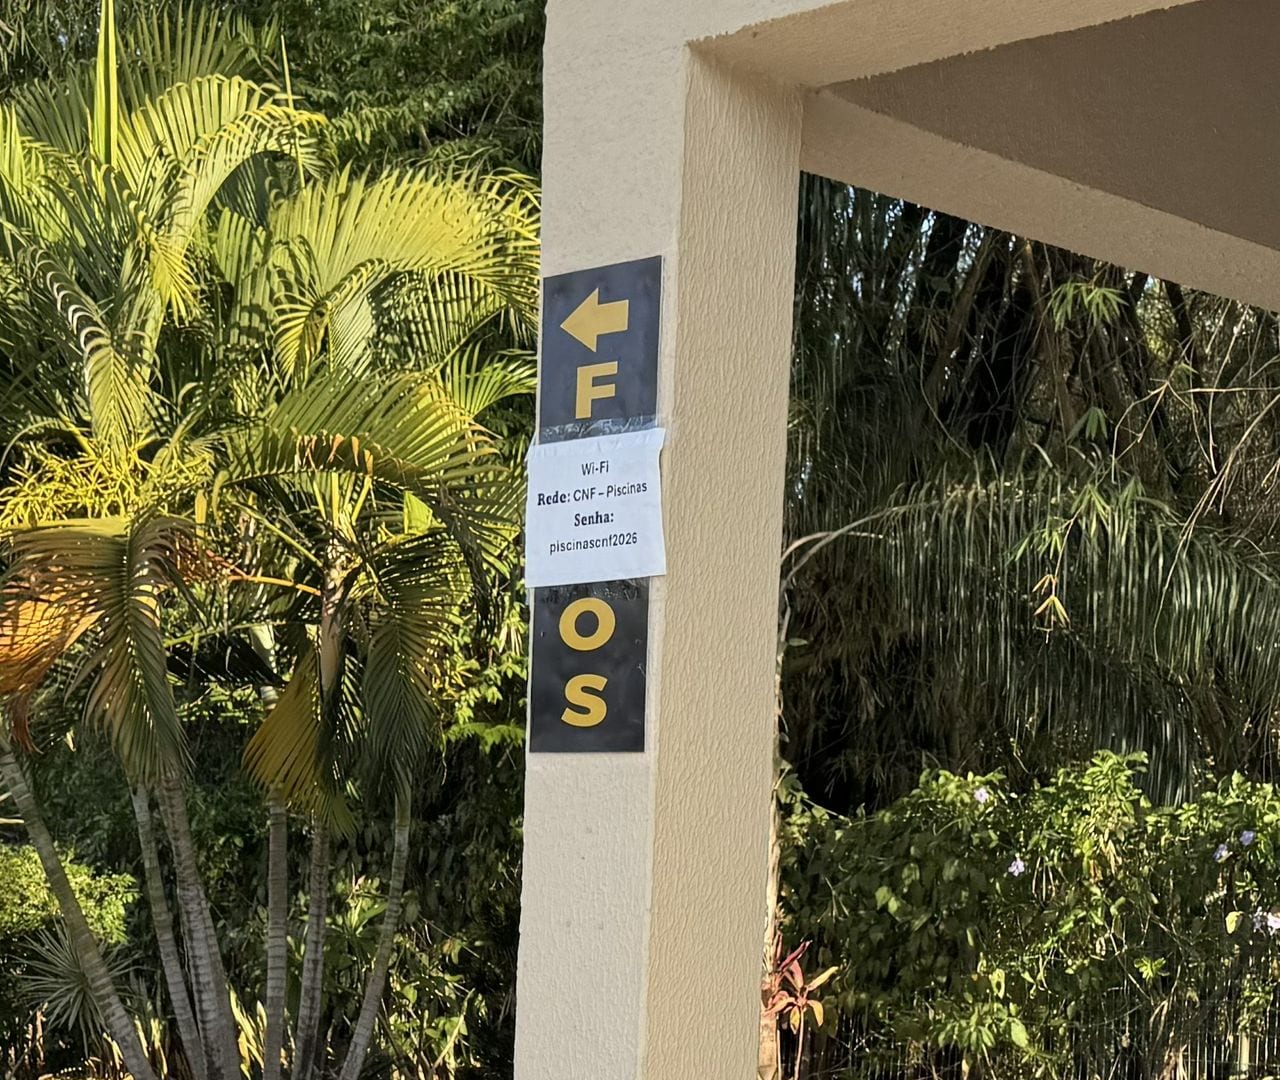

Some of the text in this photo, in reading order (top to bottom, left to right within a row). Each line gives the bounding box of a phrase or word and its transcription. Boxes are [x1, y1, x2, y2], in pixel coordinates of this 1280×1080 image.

[581, 460, 609, 476] Wi-Fi
[537, 490, 571, 506] Rede:
[573, 487, 596, 502] CNF
[606, 482, 648, 498] Piscinas
[574, 511, 614, 527] Senha:
[549, 532, 638, 555] piscinascnf2026
